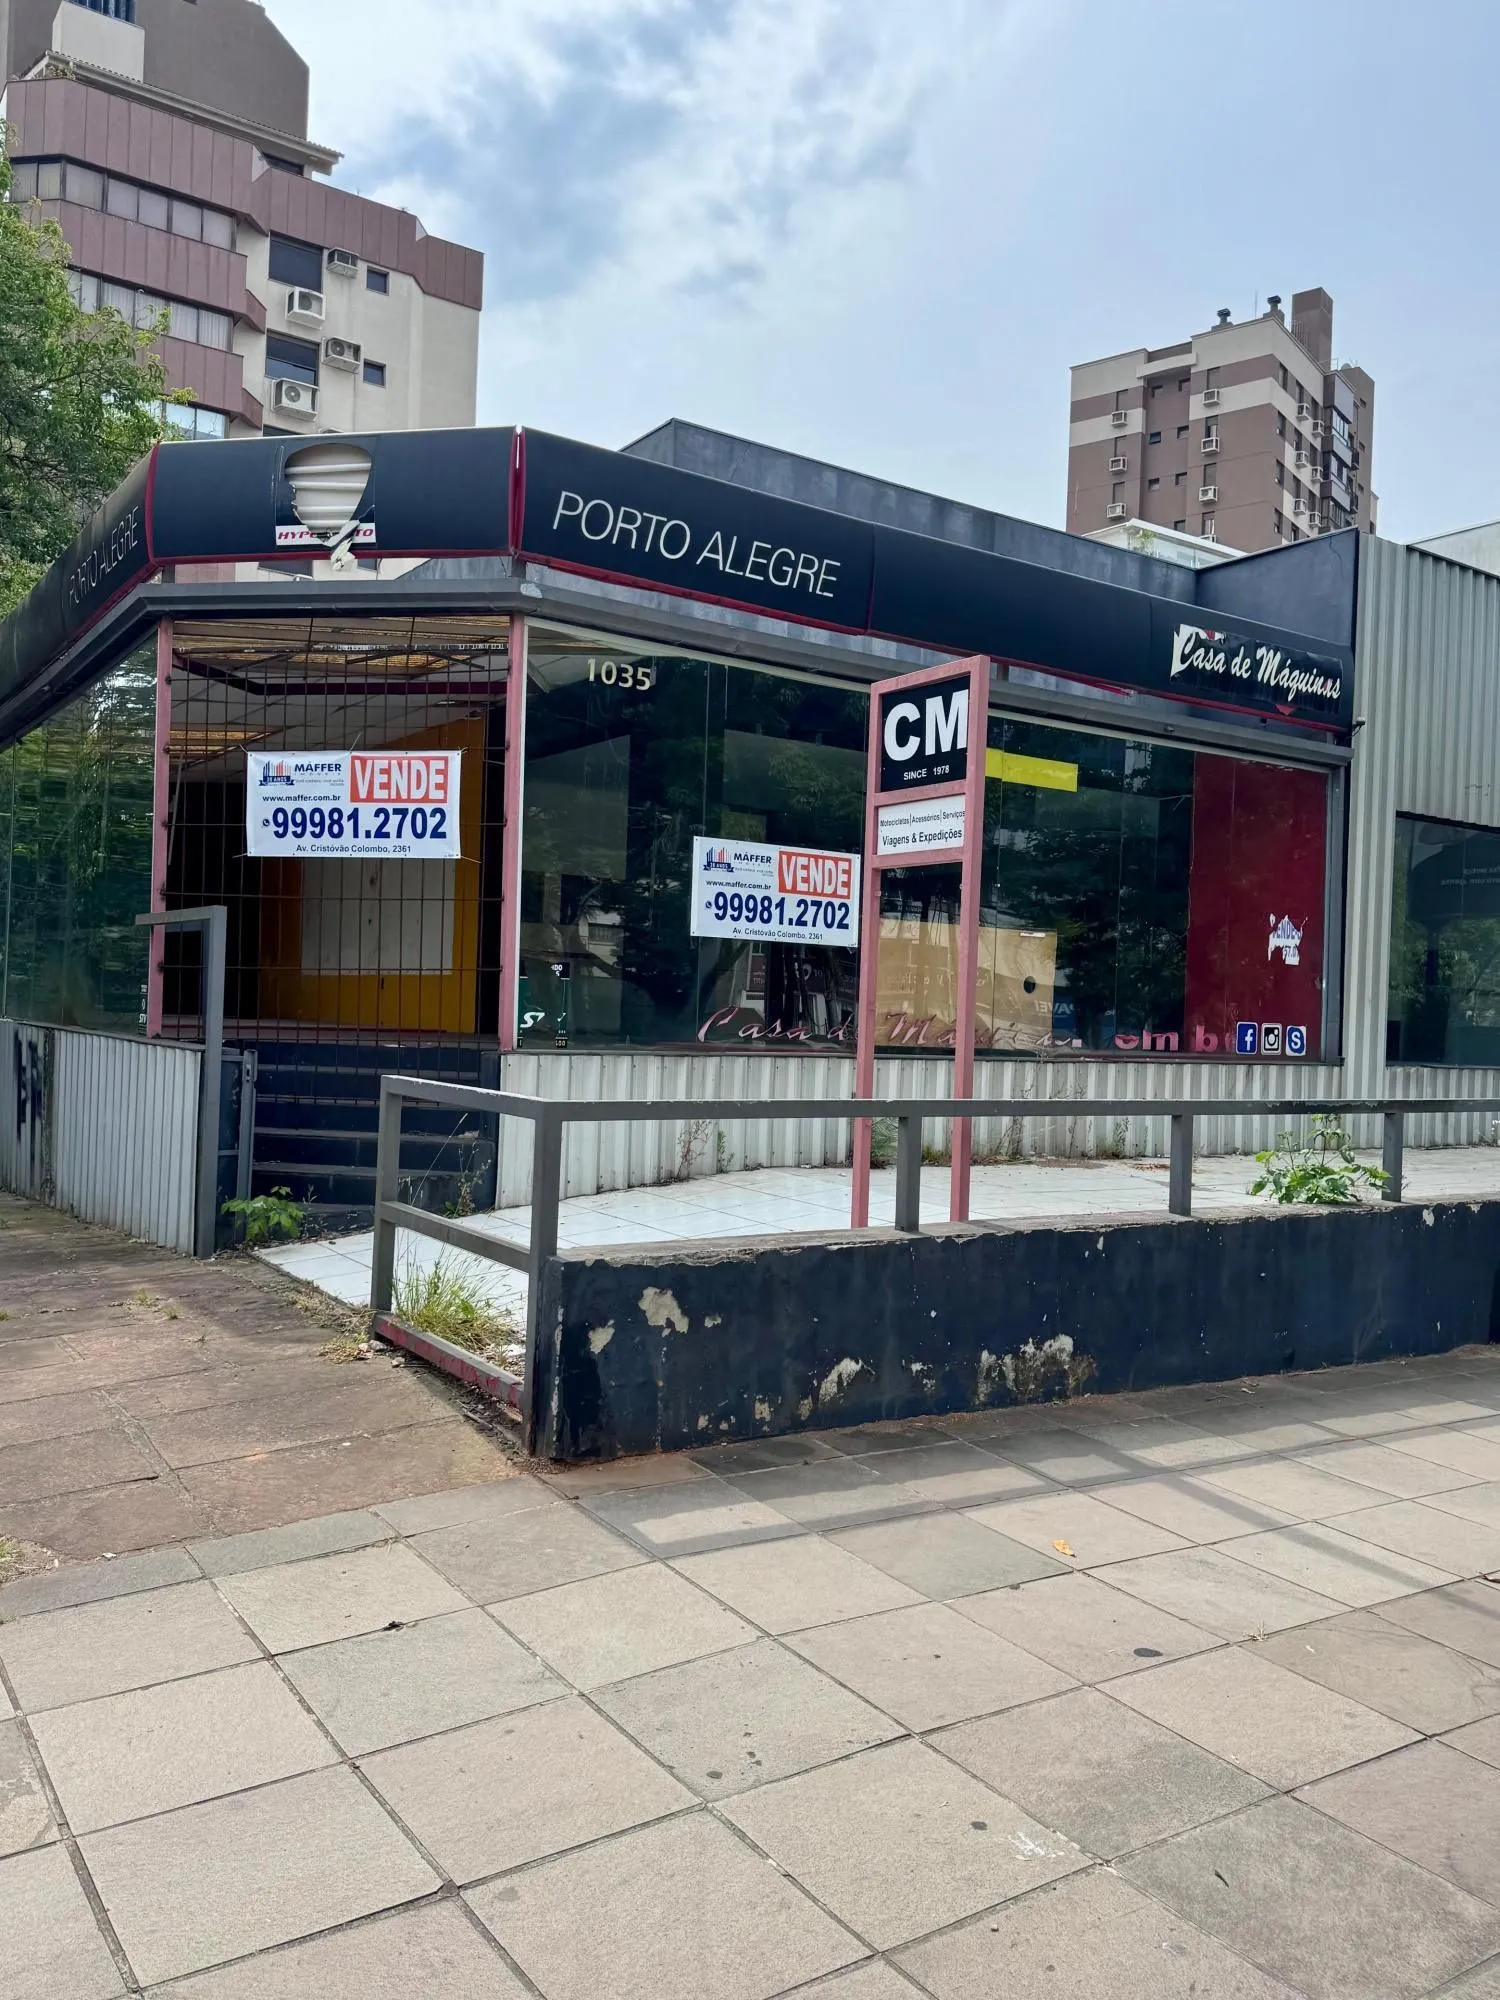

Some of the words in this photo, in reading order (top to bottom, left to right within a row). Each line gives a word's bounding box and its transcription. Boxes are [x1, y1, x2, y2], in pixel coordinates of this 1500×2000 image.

[99, 505, 138, 579] ALEGRE
[553, 491, 691, 560] PORTO
[696, 531, 841, 598] ALEGRE
[588, 659, 651, 690] 1035
[1180, 631, 1226, 674] Casa
[1231, 646, 1251, 678] de
[1256, 646, 1341, 701] Máquinas
[884, 689, 969, 761] CM
[354, 759, 446, 800] VENDE
[903, 768, 927, 780] SINCE
[933, 765, 950, 775] 1978
[262, 794, 341, 802] www.maffer.com.br
[272, 807, 447, 839] 99981.2702
[882, 835, 909, 847] Viagens
[912, 833, 917, 843] &
[919, 829, 962, 844] Expedições
[351, 845, 390, 853] Colombo,
[706, 880, 772, 890] www.maffer.com.br
[781, 855, 849, 896] VENDE
[714, 891, 850, 930] 99981.2702
[808, 932, 823, 940] 2361
[697, 1005, 812, 1042] Casa
